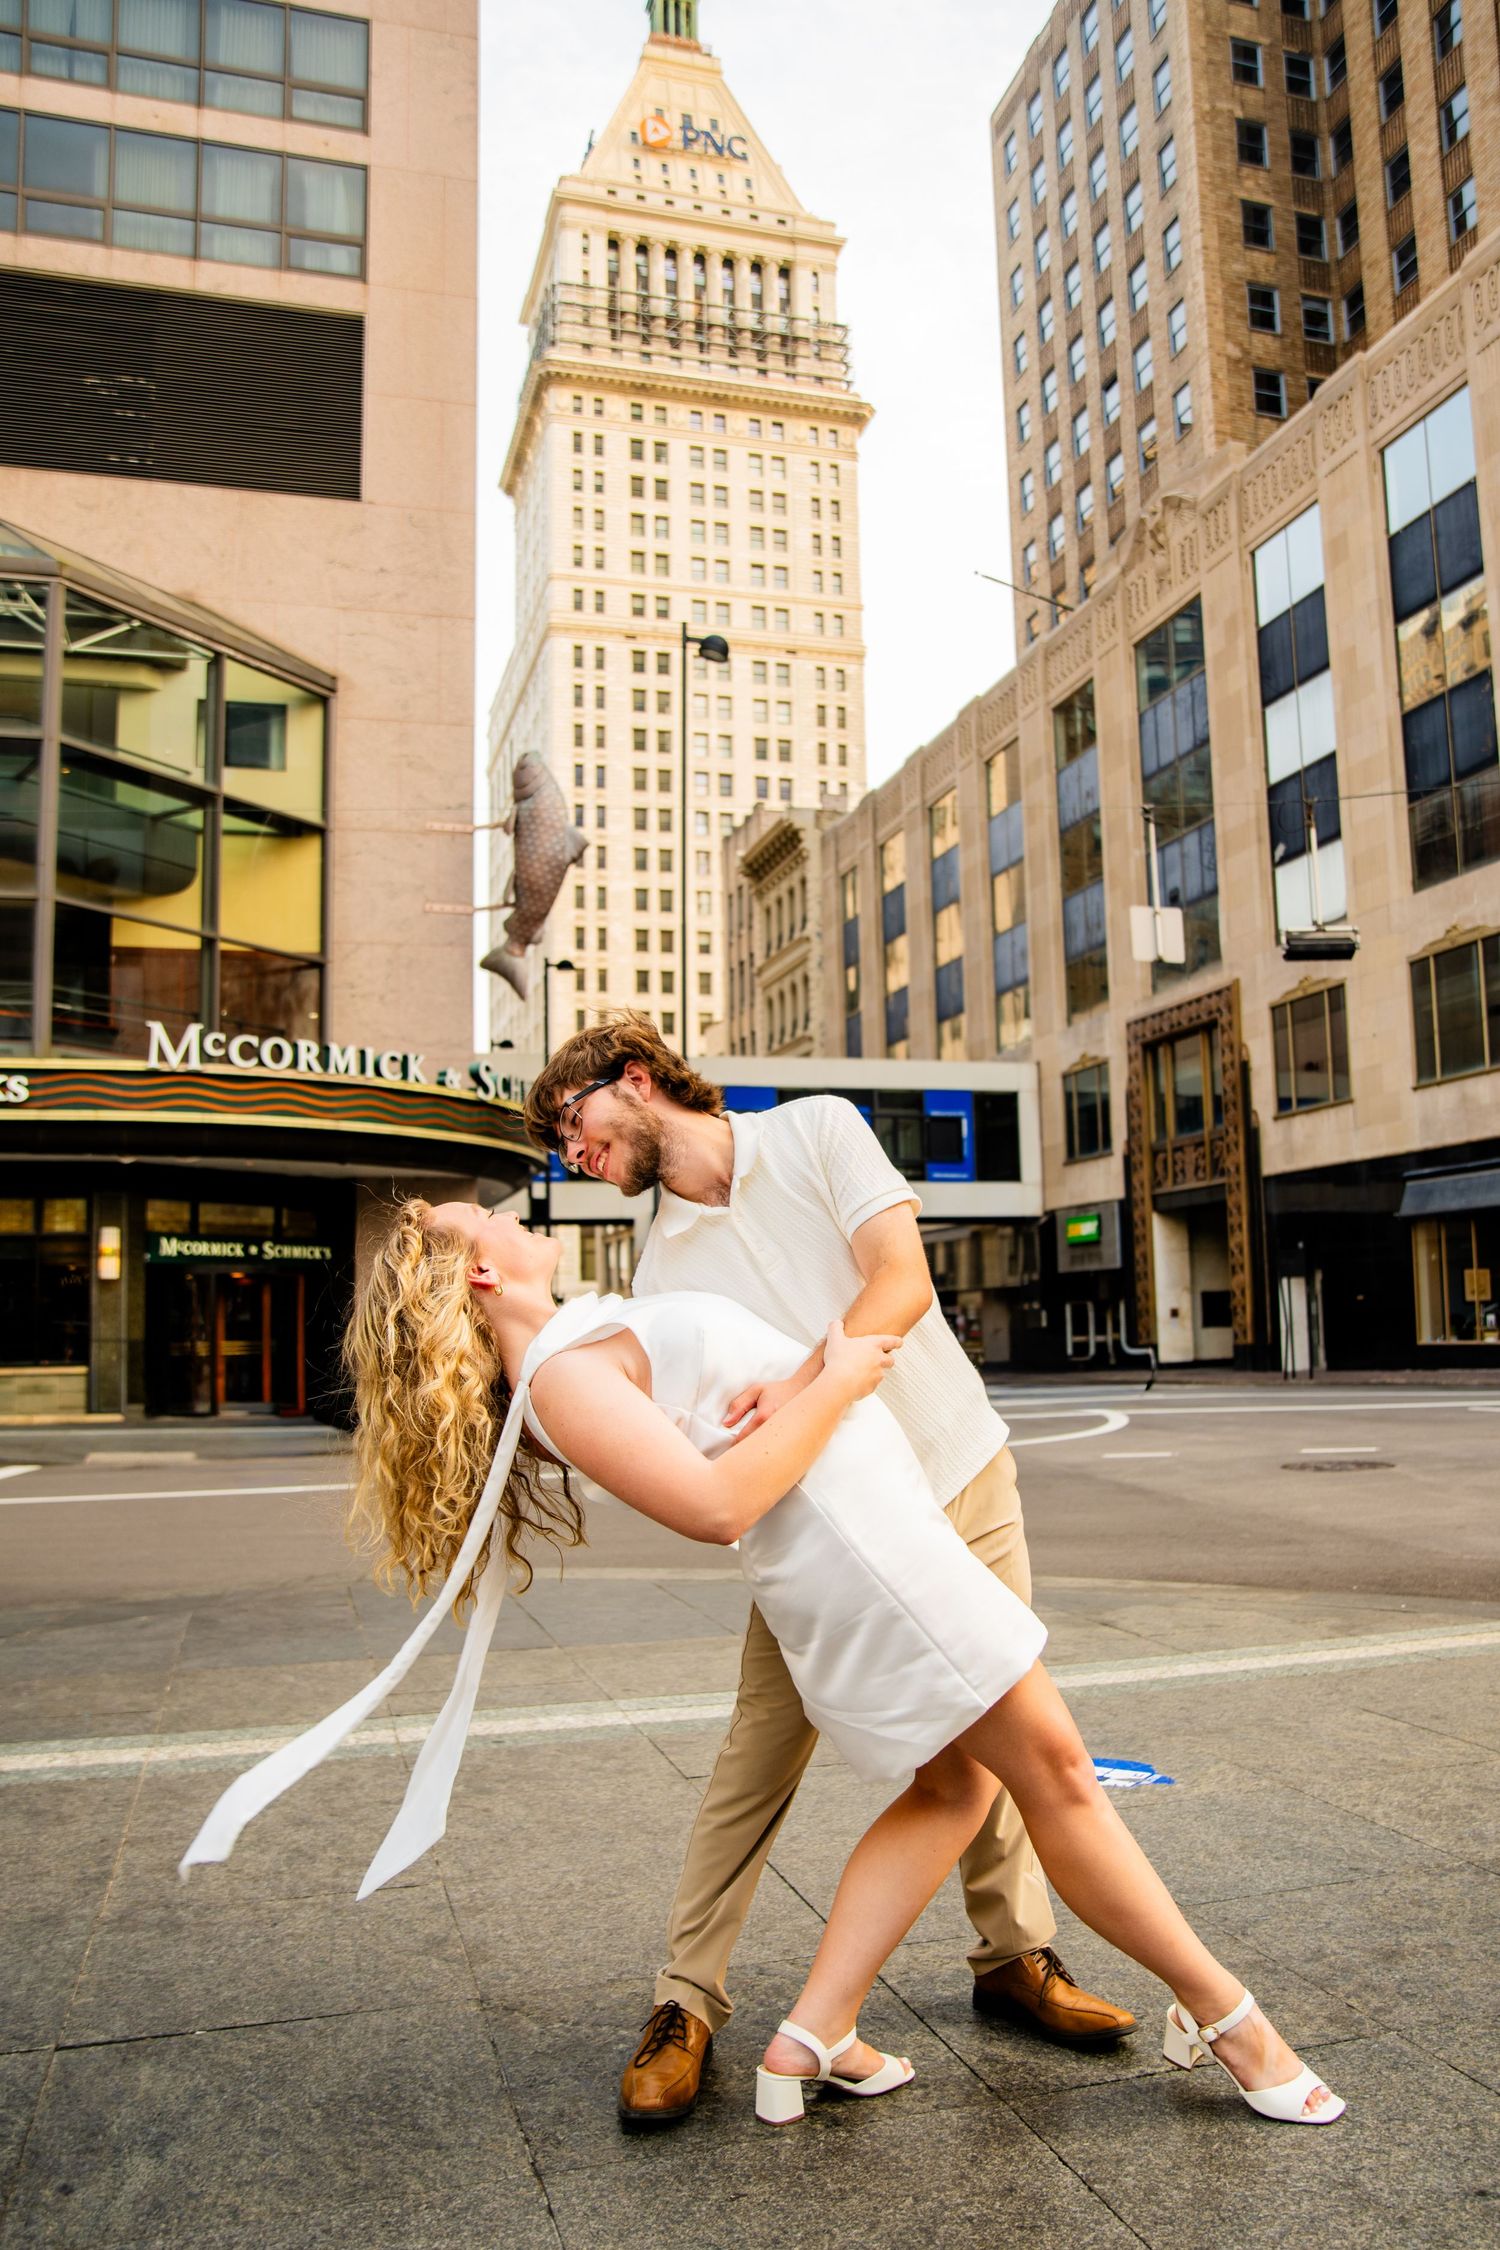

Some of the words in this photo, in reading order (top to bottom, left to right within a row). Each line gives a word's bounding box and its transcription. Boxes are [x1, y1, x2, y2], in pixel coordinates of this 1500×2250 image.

[679, 126, 748, 161] PNC
[440, 1066, 462, 1090] &
[470, 1059, 530, 1107] SCH
